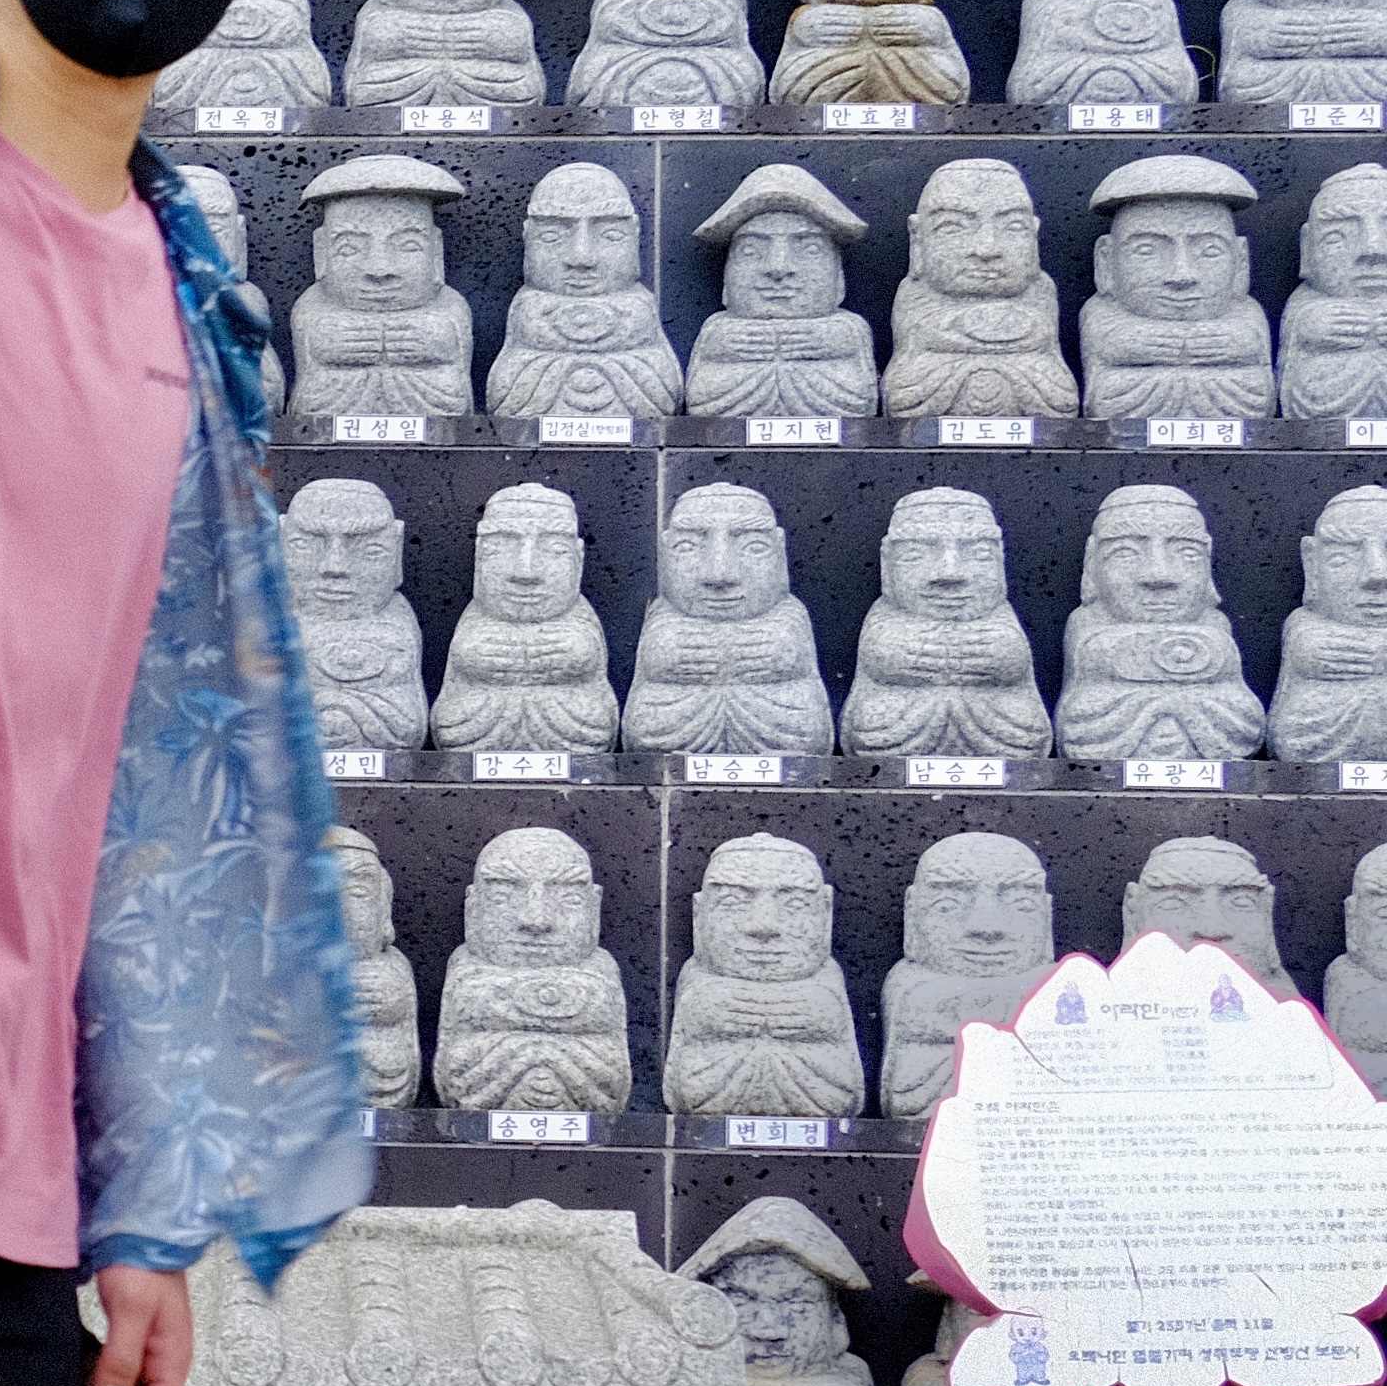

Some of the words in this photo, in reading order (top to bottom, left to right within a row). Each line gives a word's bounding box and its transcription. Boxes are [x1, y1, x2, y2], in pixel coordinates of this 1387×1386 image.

[409, 109, 484, 129] 안용석
[639, 108, 714, 128] 안형철
[831, 106, 908, 127] 안효철
[1078, 107, 1154, 127] 김용태
[1299, 105, 1375, 127] 김준식
[342, 418, 418, 439] 권성일
[755, 420, 833, 442] 김지현
[946, 420, 1026, 442] 김도유
[1156, 421, 1235, 443] 이희령
[329, 753, 377, 775] 성민
[481, 757, 563, 777] 강수진
[692, 758, 775, 780] 남승우
[914, 760, 997, 783] 남승수
[1132, 763, 1216, 785] 유광식
[498, 1117, 582, 1137] 송영주
[737, 1123, 818, 1144] 변희경
